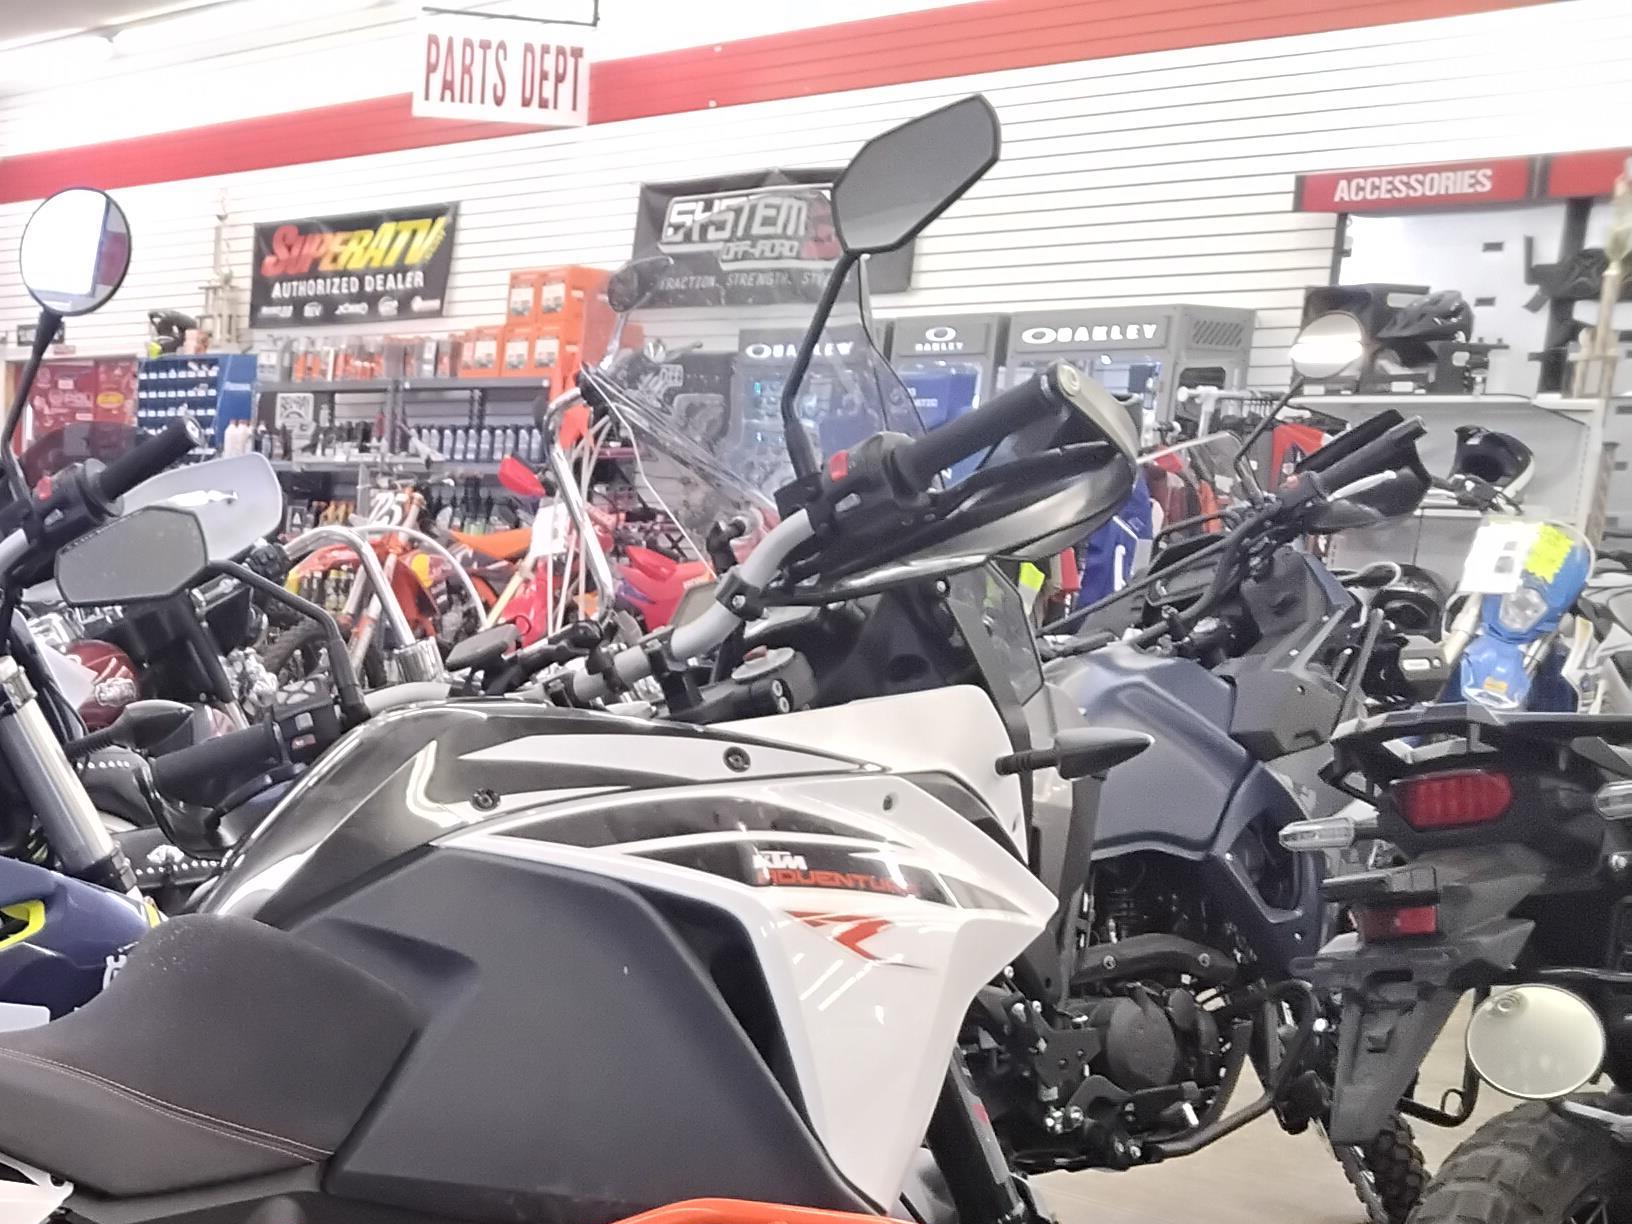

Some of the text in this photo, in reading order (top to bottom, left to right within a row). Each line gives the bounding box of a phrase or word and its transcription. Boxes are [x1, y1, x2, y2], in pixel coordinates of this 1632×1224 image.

[424, 33, 584, 111] PARTS DEPT
[1334, 168, 1493, 202] ACCESSORIES
[662, 196, 808, 242] SYSTEM
[271, 271, 424, 299] AUTHORIZED DEALER
[1056, 324, 1157, 343] OAKLEY
[772, 341, 854, 358] OALEY
[753, 851, 808, 870] KTM
